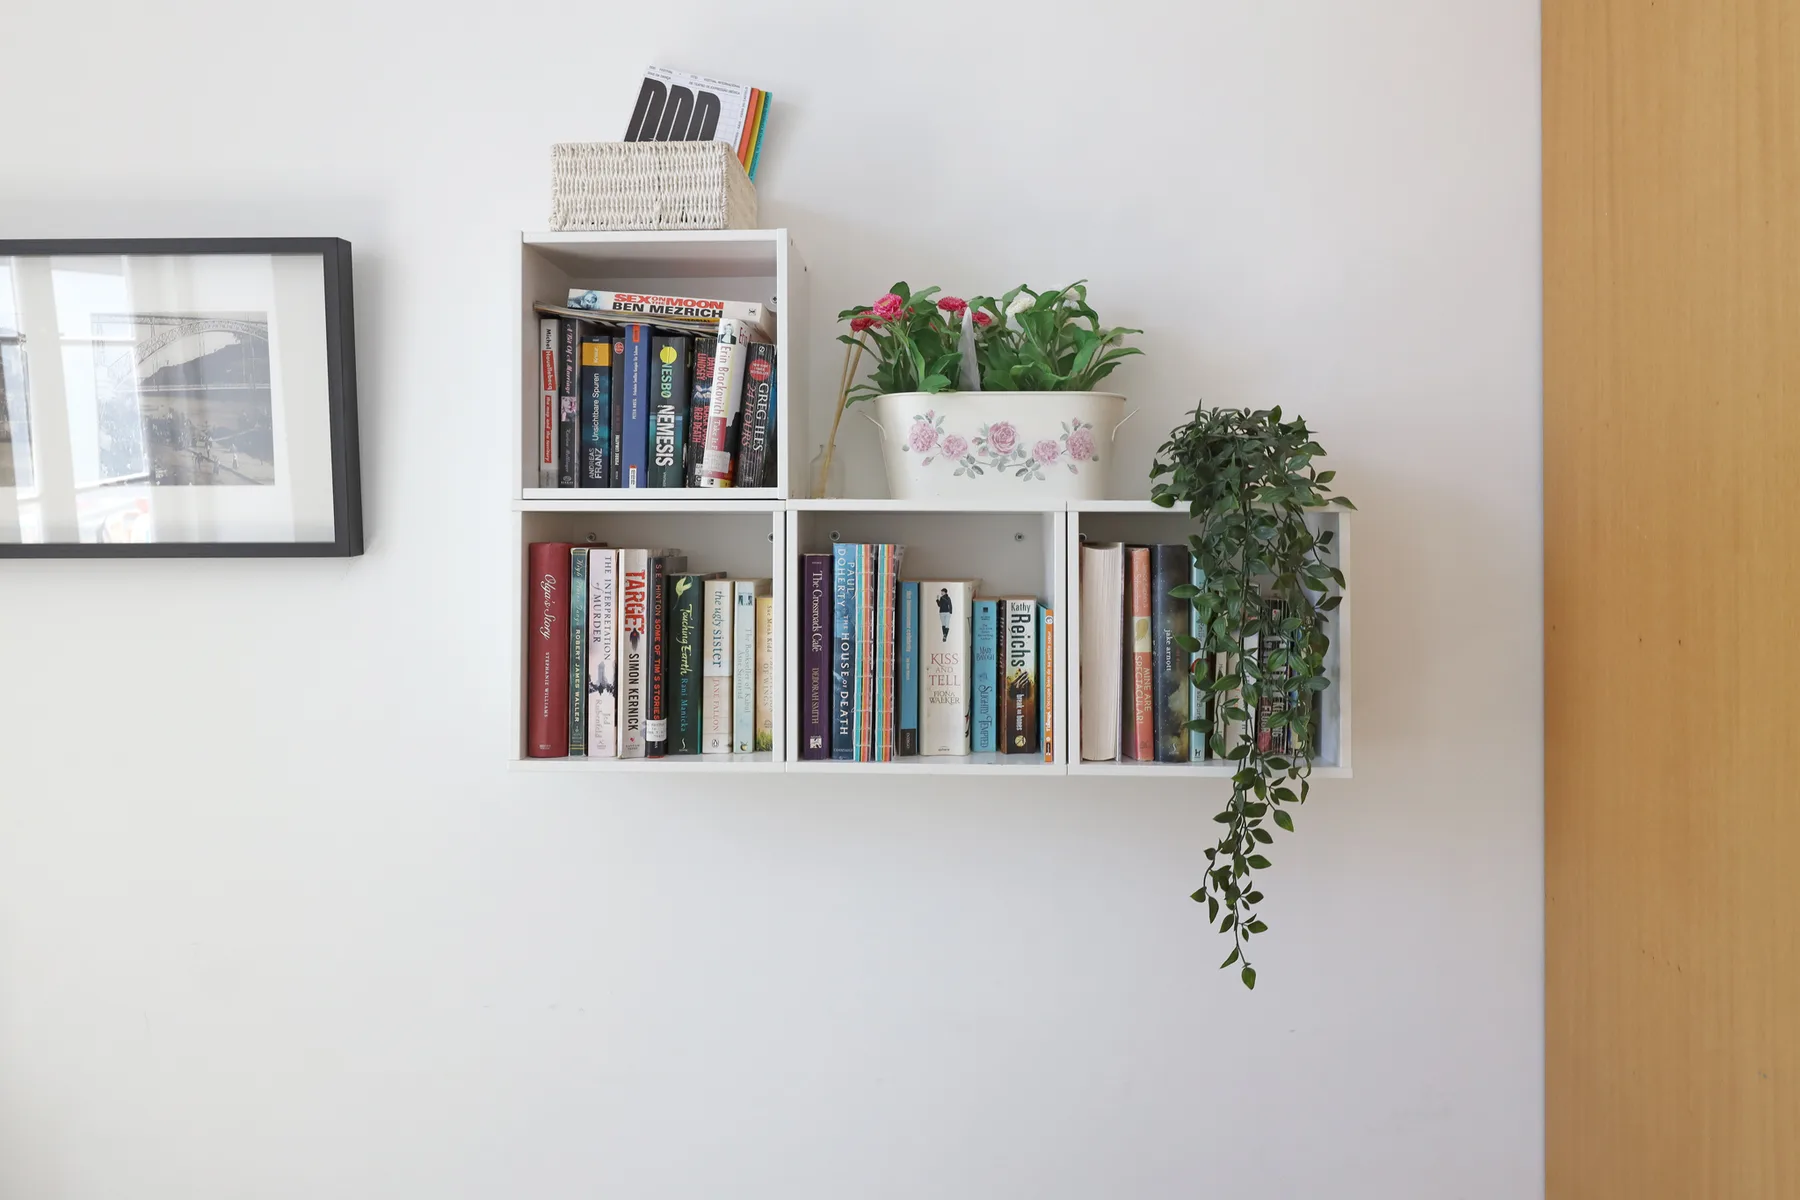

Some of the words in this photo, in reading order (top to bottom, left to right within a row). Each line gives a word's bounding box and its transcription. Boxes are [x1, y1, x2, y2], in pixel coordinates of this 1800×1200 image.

[612, 302, 644, 312] BEN
[649, 305, 724, 318] MEZRICH
[614, 293, 650, 303] SEX
[665, 298, 724, 310] MOON
[696, 353, 708, 381] LINDSEY
[720, 346, 732, 364] Erin
[564, 362, 573, 395] Marriage
[592, 372, 601, 398] Spuren
[713, 366, 730, 415] Brockovich
[746, 383, 757, 399] 24
[693, 407, 704, 420] RED
[755, 383, 769, 420] GREG
[592, 399, 600, 441] Unsichtbare
[691, 421, 702, 444] DEATH
[711, 419, 721, 436] Take
[741, 402, 754, 447] HOURS
[656, 404, 676, 467] NEMESIS
[752, 425, 765, 452] ILES
[544, 439, 552, 462] territory
[595, 447, 603, 479] FRANZ
[574, 559, 583, 577] High
[604, 556, 612, 575] THE
[837, 548, 847, 608] DOHERTY
[846, 561, 855, 594] PAUL
[540, 573, 557, 609] Olga's
[591, 582, 604, 594] of
[812, 570, 823, 588] The
[624, 569, 646, 635] TARGET
[714, 590, 725, 606] the
[812, 588, 823, 633] Crossroads
[1010, 602, 1031, 613] Kathy
[539, 608, 557, 641] Story
[592, 594, 602, 643] MURDER
[603, 579, 612, 661] INTERPRETATION
[675, 603, 695, 644] Touching
[712, 607, 725, 627] ugly
[712, 629, 724, 668] sister
[1010, 613, 1031, 667] Reichs
[1164, 628, 1173, 645] jake
[654, 646, 661, 657] OF
[680, 644, 693, 676] Earth
[744, 644, 752, 681] Bookseller
[840, 632, 850, 677] HOUSE
[931, 653, 959, 668] KISS
[628, 653, 640, 685] SIMON
[653, 659, 662, 682] TIM'S
[763, 663, 769, 676] OF
[811, 667, 820, 697] DEBORAH
[928, 674, 960, 687] TELL
[935, 666, 954, 674] AND
[1143, 667, 1151, 691] MINE
[680, 678, 689, 696] Rani
[712, 678, 720, 701] JANE
[745, 682, 752, 692] of
[842, 679, 848, 688] OF
[933, 690, 956, 698] FIONA
[627, 688, 639, 731] KERNICK
[811, 697, 819, 724] SMITH
[839, 690, 849, 735] DEATH
[928, 696, 960, 706] WALKER
[978, 684, 993, 715] SLIGHTLY
[1016, 693, 1025, 709] break
[1144, 694, 1152, 712] ARE
[603, 713, 611, 725] Jed
[680, 699, 689, 732] Manicka
[712, 701, 720, 731] FALLON
[1016, 715, 1025, 731] bones
[1271, 702, 1285, 738] KING
[978, 715, 993, 749] TEMPTED
